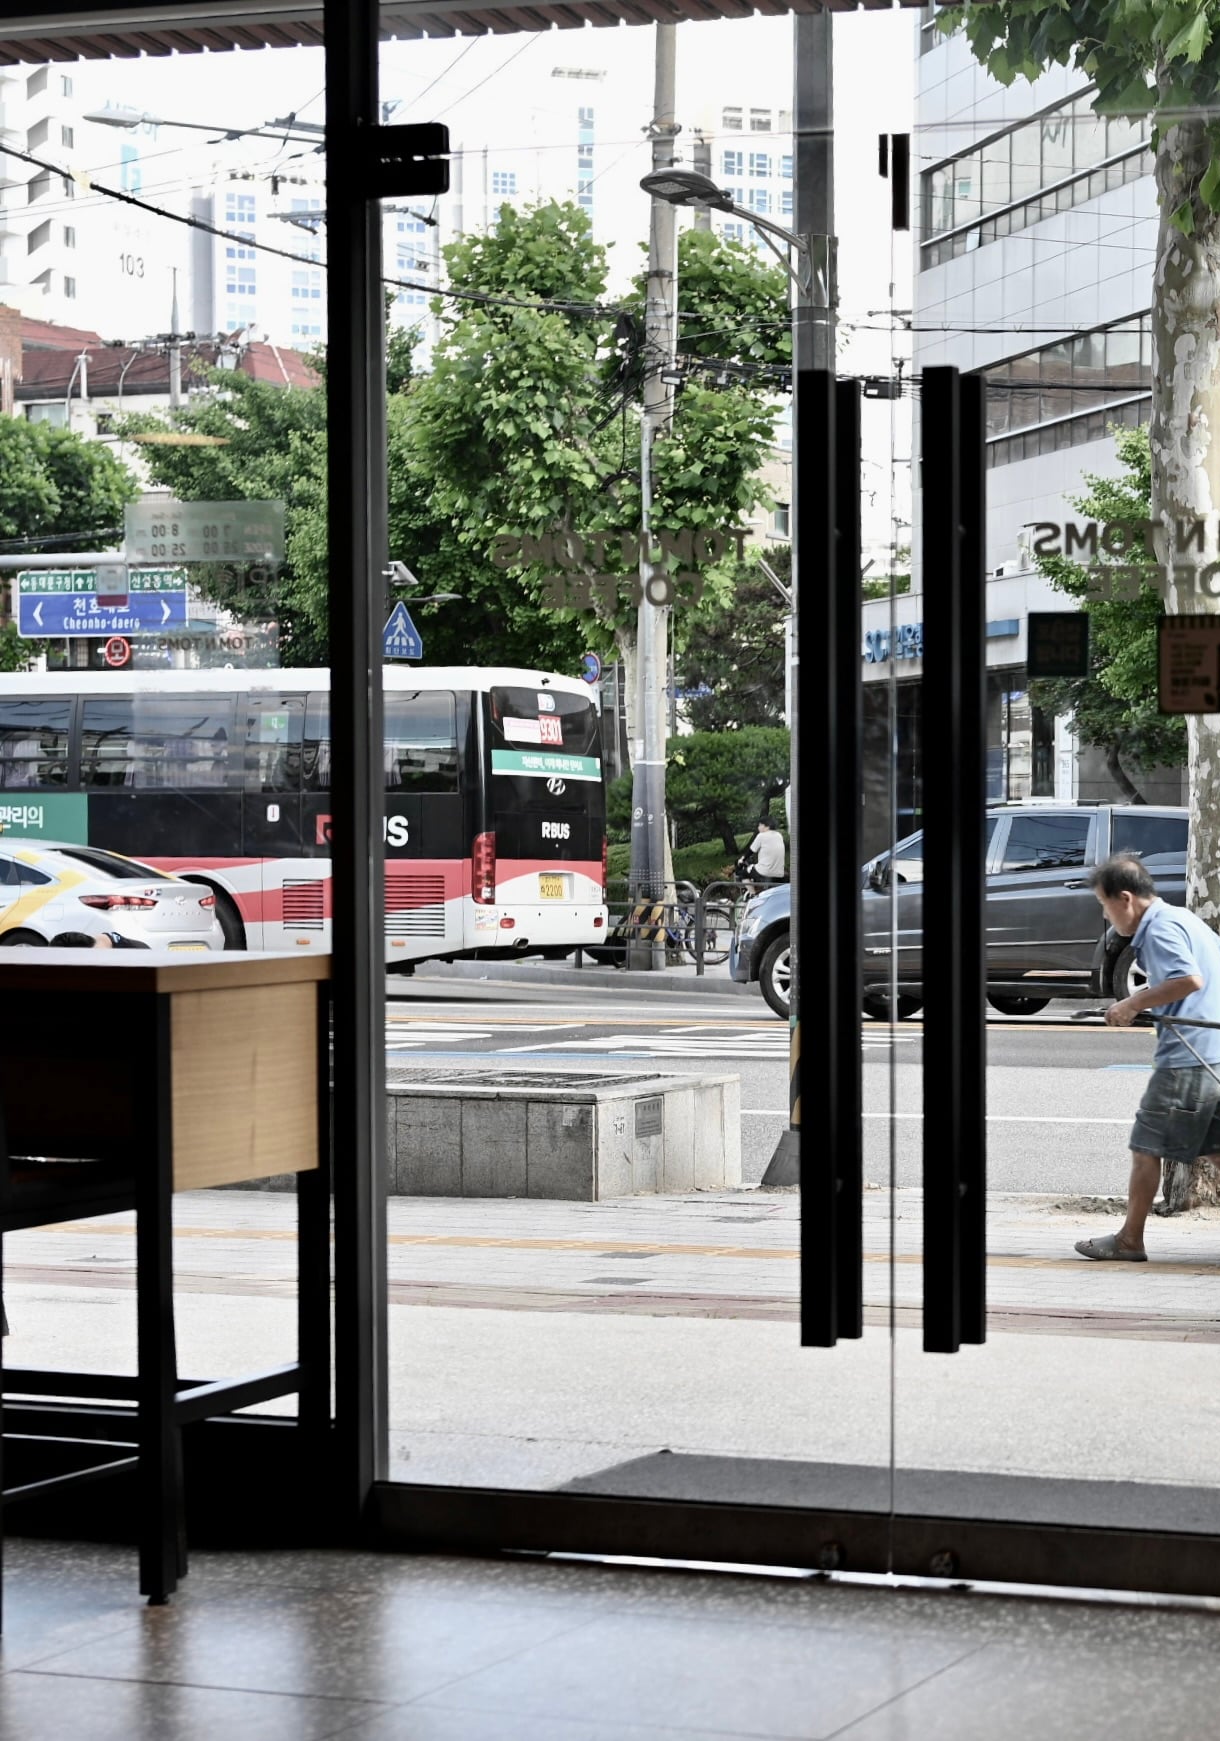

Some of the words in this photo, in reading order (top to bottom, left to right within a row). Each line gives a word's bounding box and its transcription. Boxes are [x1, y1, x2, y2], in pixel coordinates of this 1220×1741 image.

[119, 252, 145, 279] 103
[30, 576, 71, 592] 동대문구청
[131, 574, 173, 589] 신설동역
[63, 616, 141, 630] Cheonho-daero
[540, 718, 563, 742] 9301
[541, 821, 571, 840] RBUS
